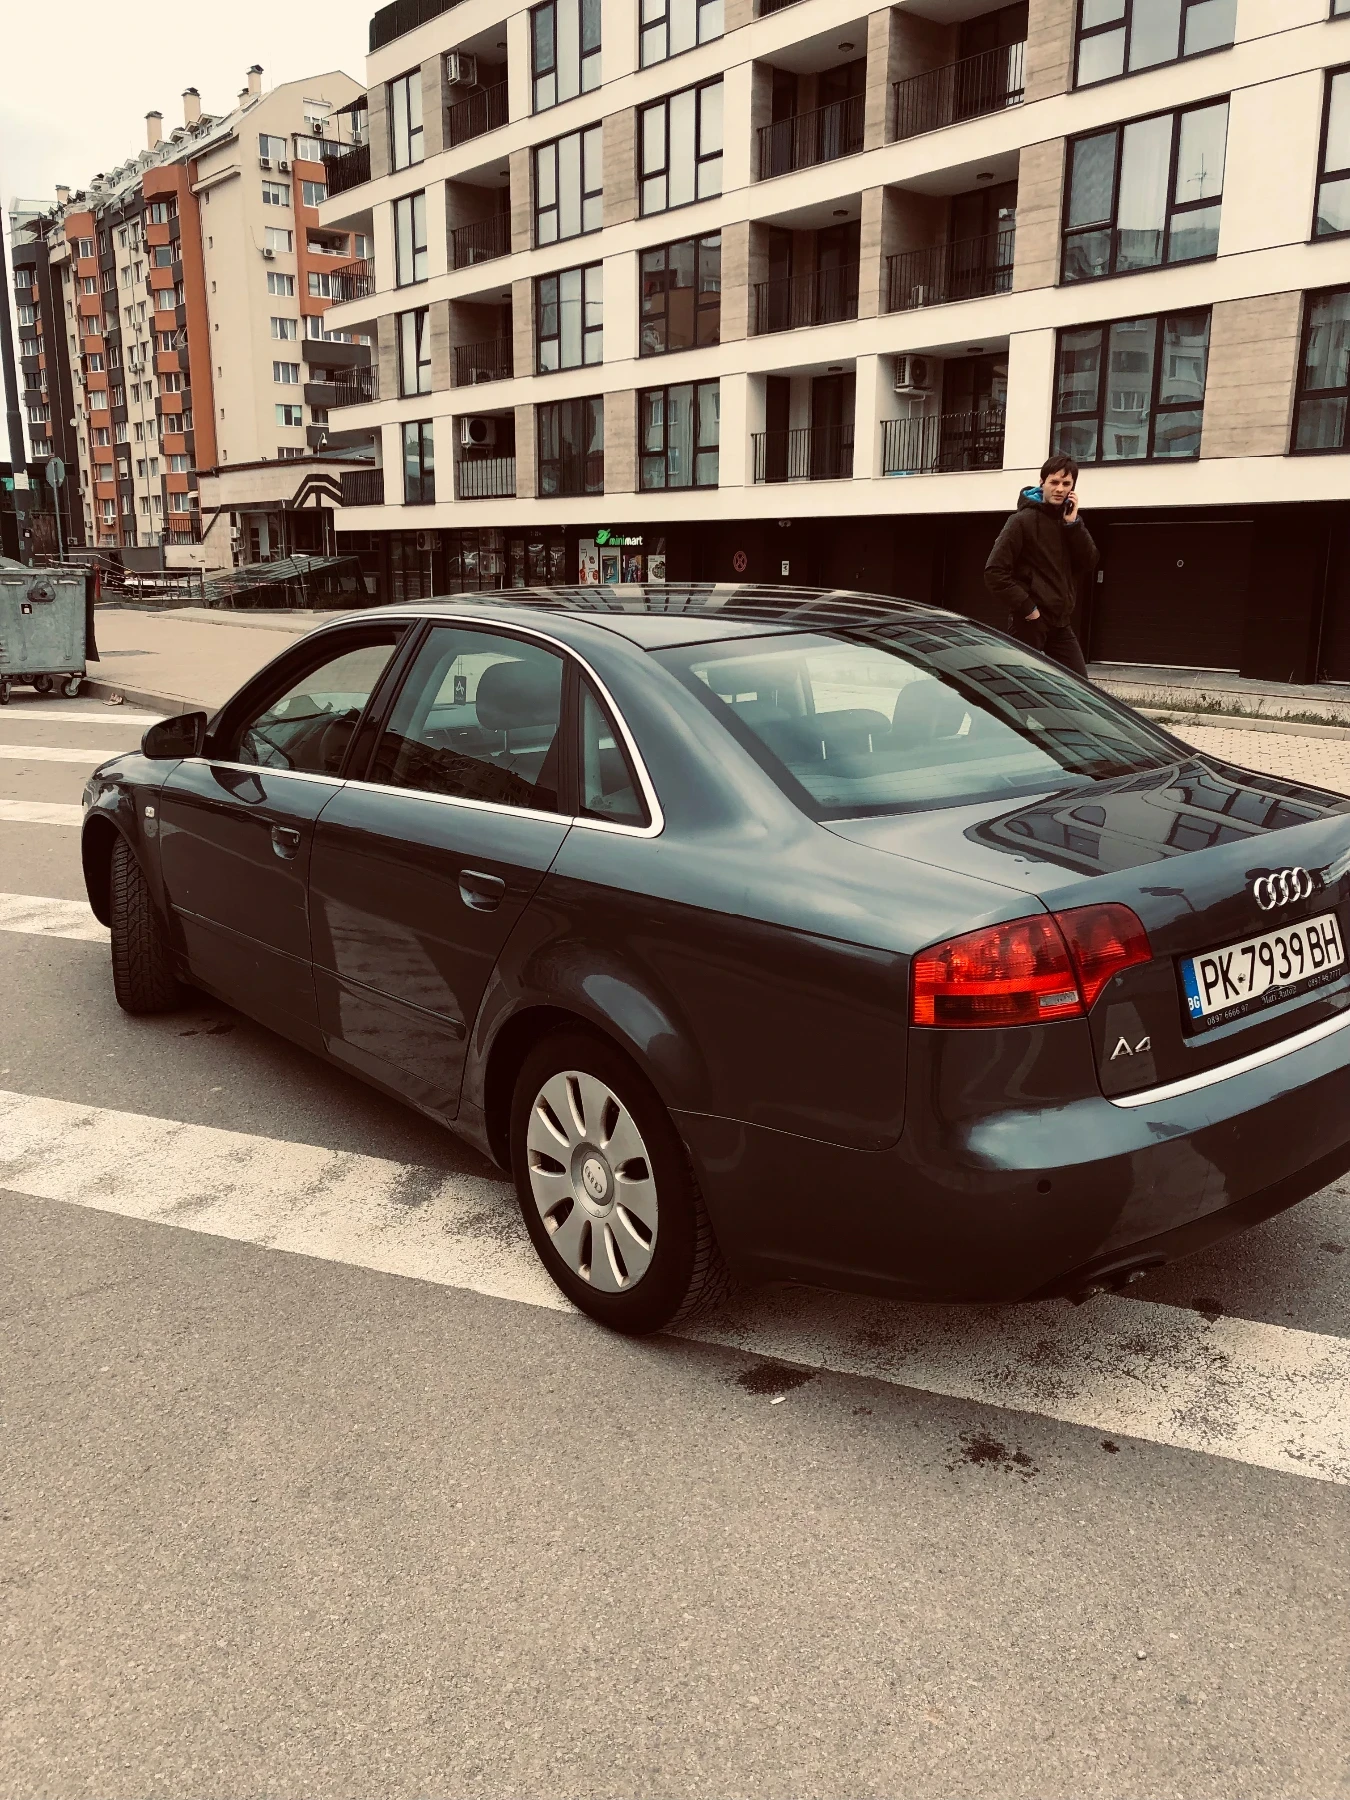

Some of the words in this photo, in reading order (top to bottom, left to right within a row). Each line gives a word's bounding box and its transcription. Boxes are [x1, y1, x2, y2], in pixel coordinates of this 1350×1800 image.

[608, 534, 643, 546] minimart
[1188, 997, 1201, 1010] BG
[1110, 1036, 1151, 1060] A4
